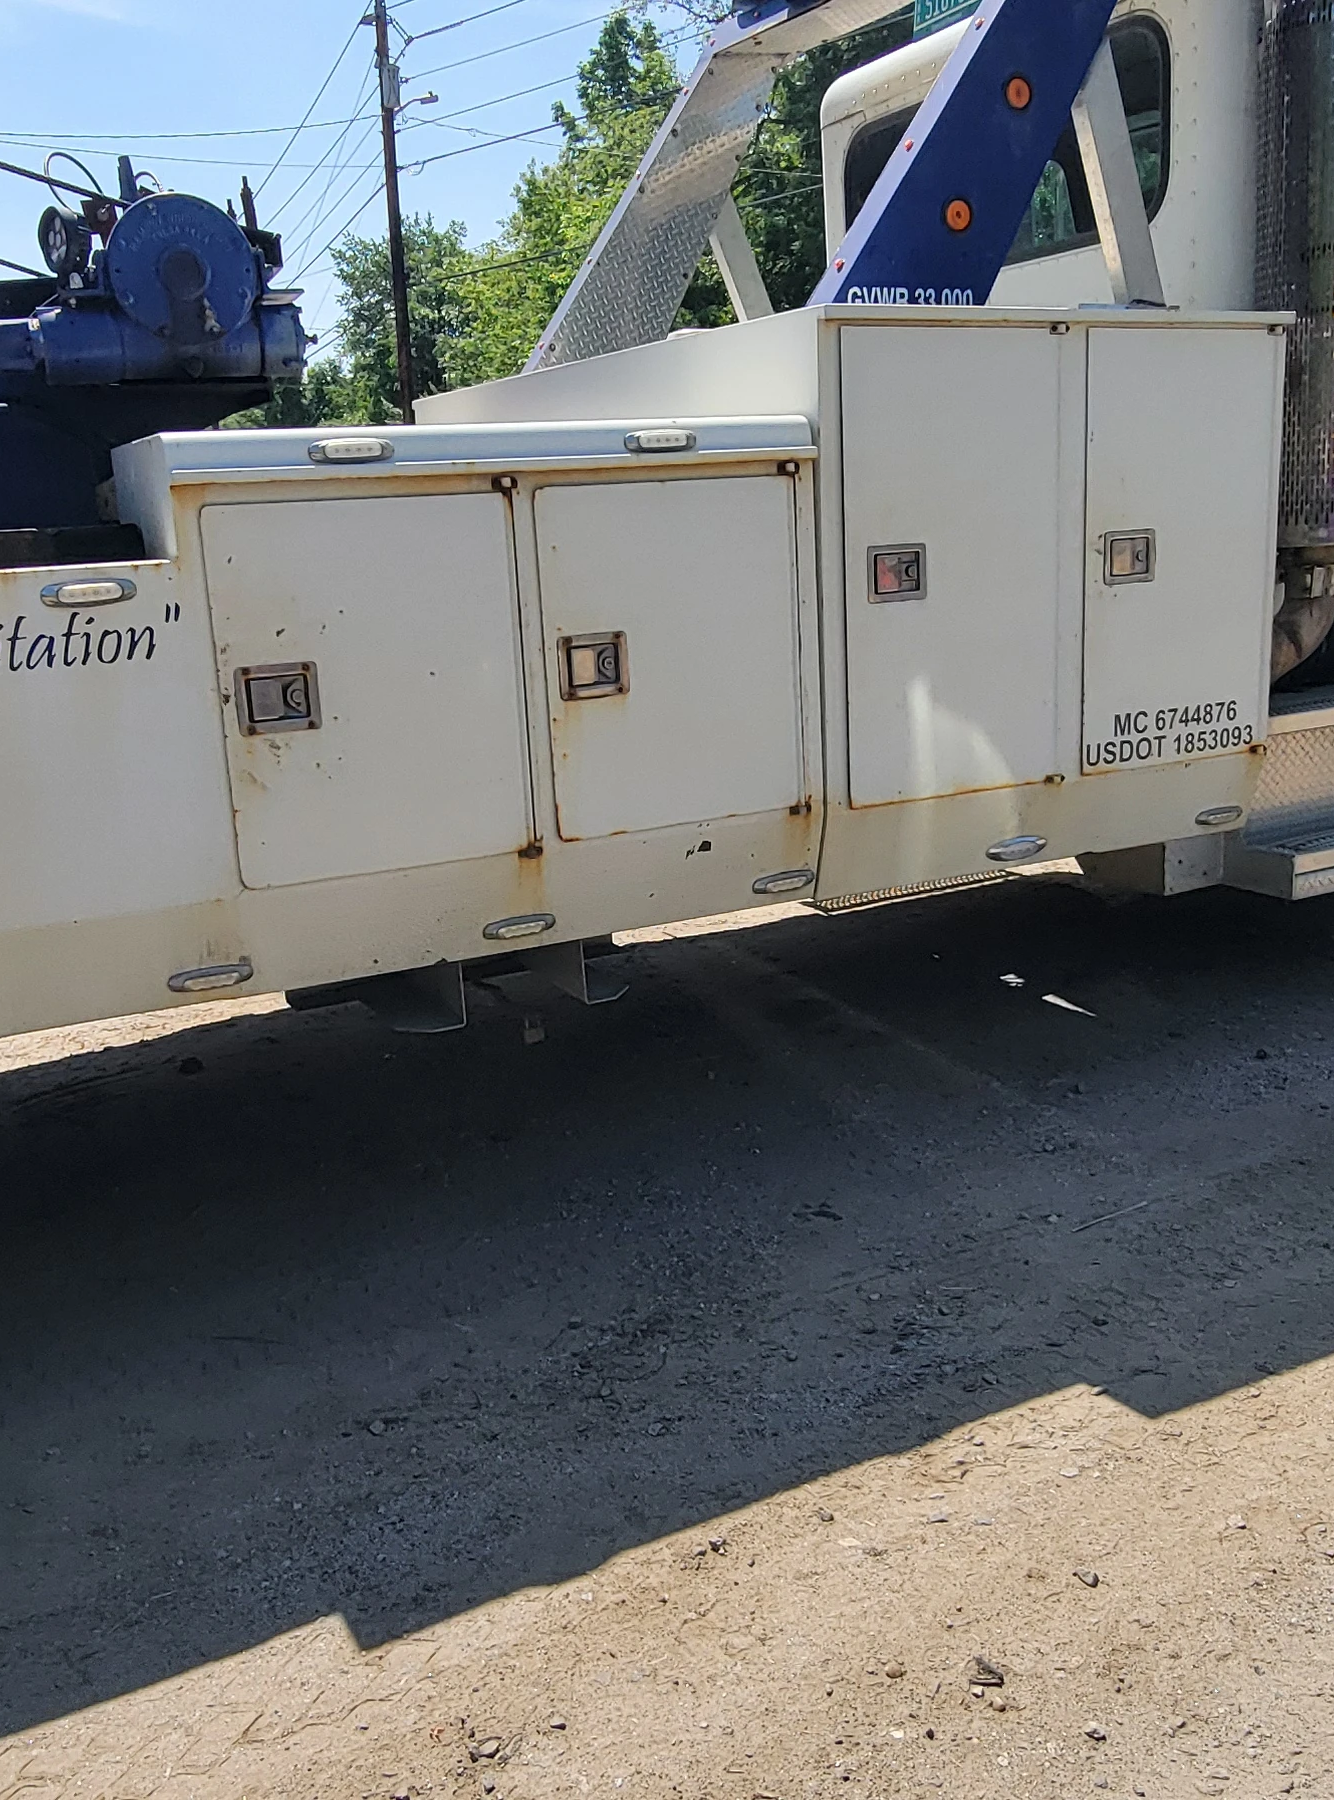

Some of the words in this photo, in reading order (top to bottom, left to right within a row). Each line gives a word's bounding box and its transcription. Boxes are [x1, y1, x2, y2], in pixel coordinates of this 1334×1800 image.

[1114, 710, 1148, 737] MC
[1155, 700, 1237, 731] 6744876
[1087, 735, 1167, 766] USDOT
[1173, 724, 1253, 755] 1853093
